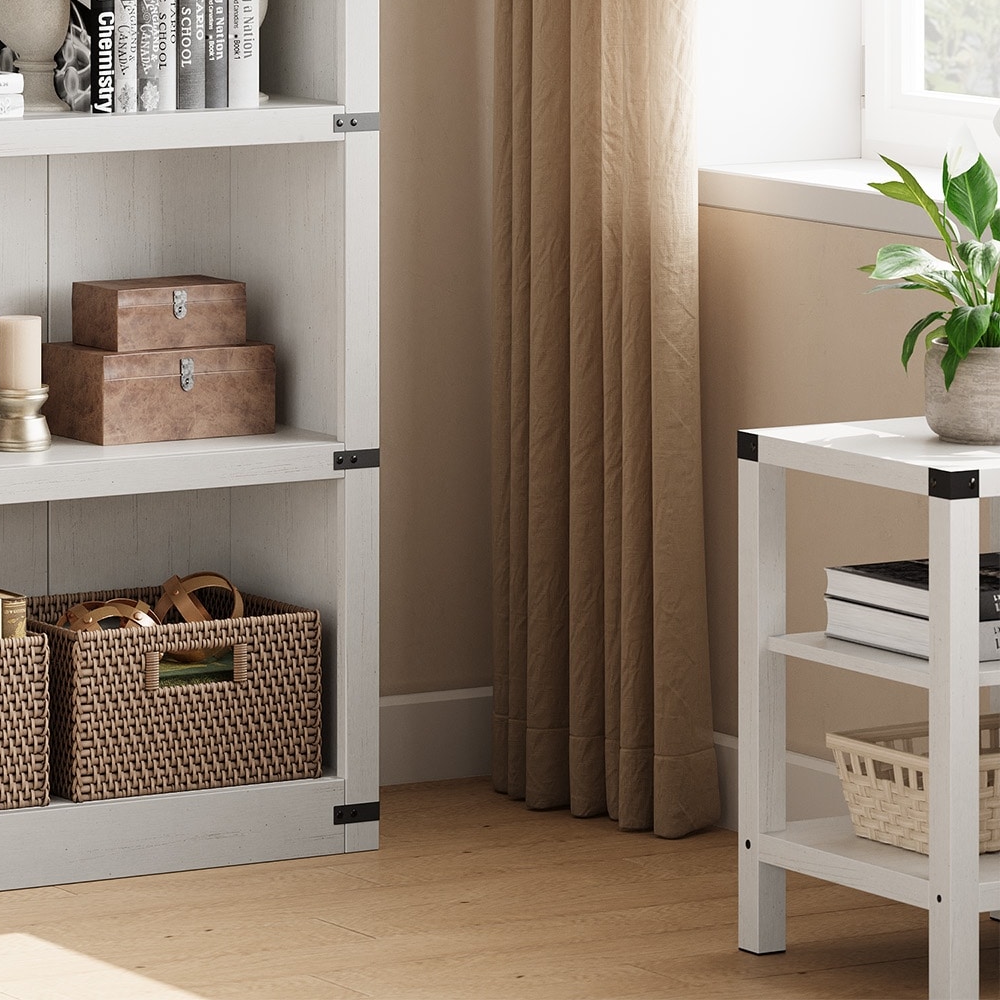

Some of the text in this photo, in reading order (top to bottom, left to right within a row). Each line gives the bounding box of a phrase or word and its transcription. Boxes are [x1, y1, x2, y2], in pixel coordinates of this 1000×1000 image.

[215, 6, 224, 14] a
[243, 5, 253, 13] a
[158, 13, 167, 70] SCHOOL
[181, 6, 192, 68] SCHOOL
[215, 17, 225, 60] Nation
[233, 39, 241, 54] Book
[243, 16, 255, 59] Nation
[94, 10, 115, 114] Chemistry
